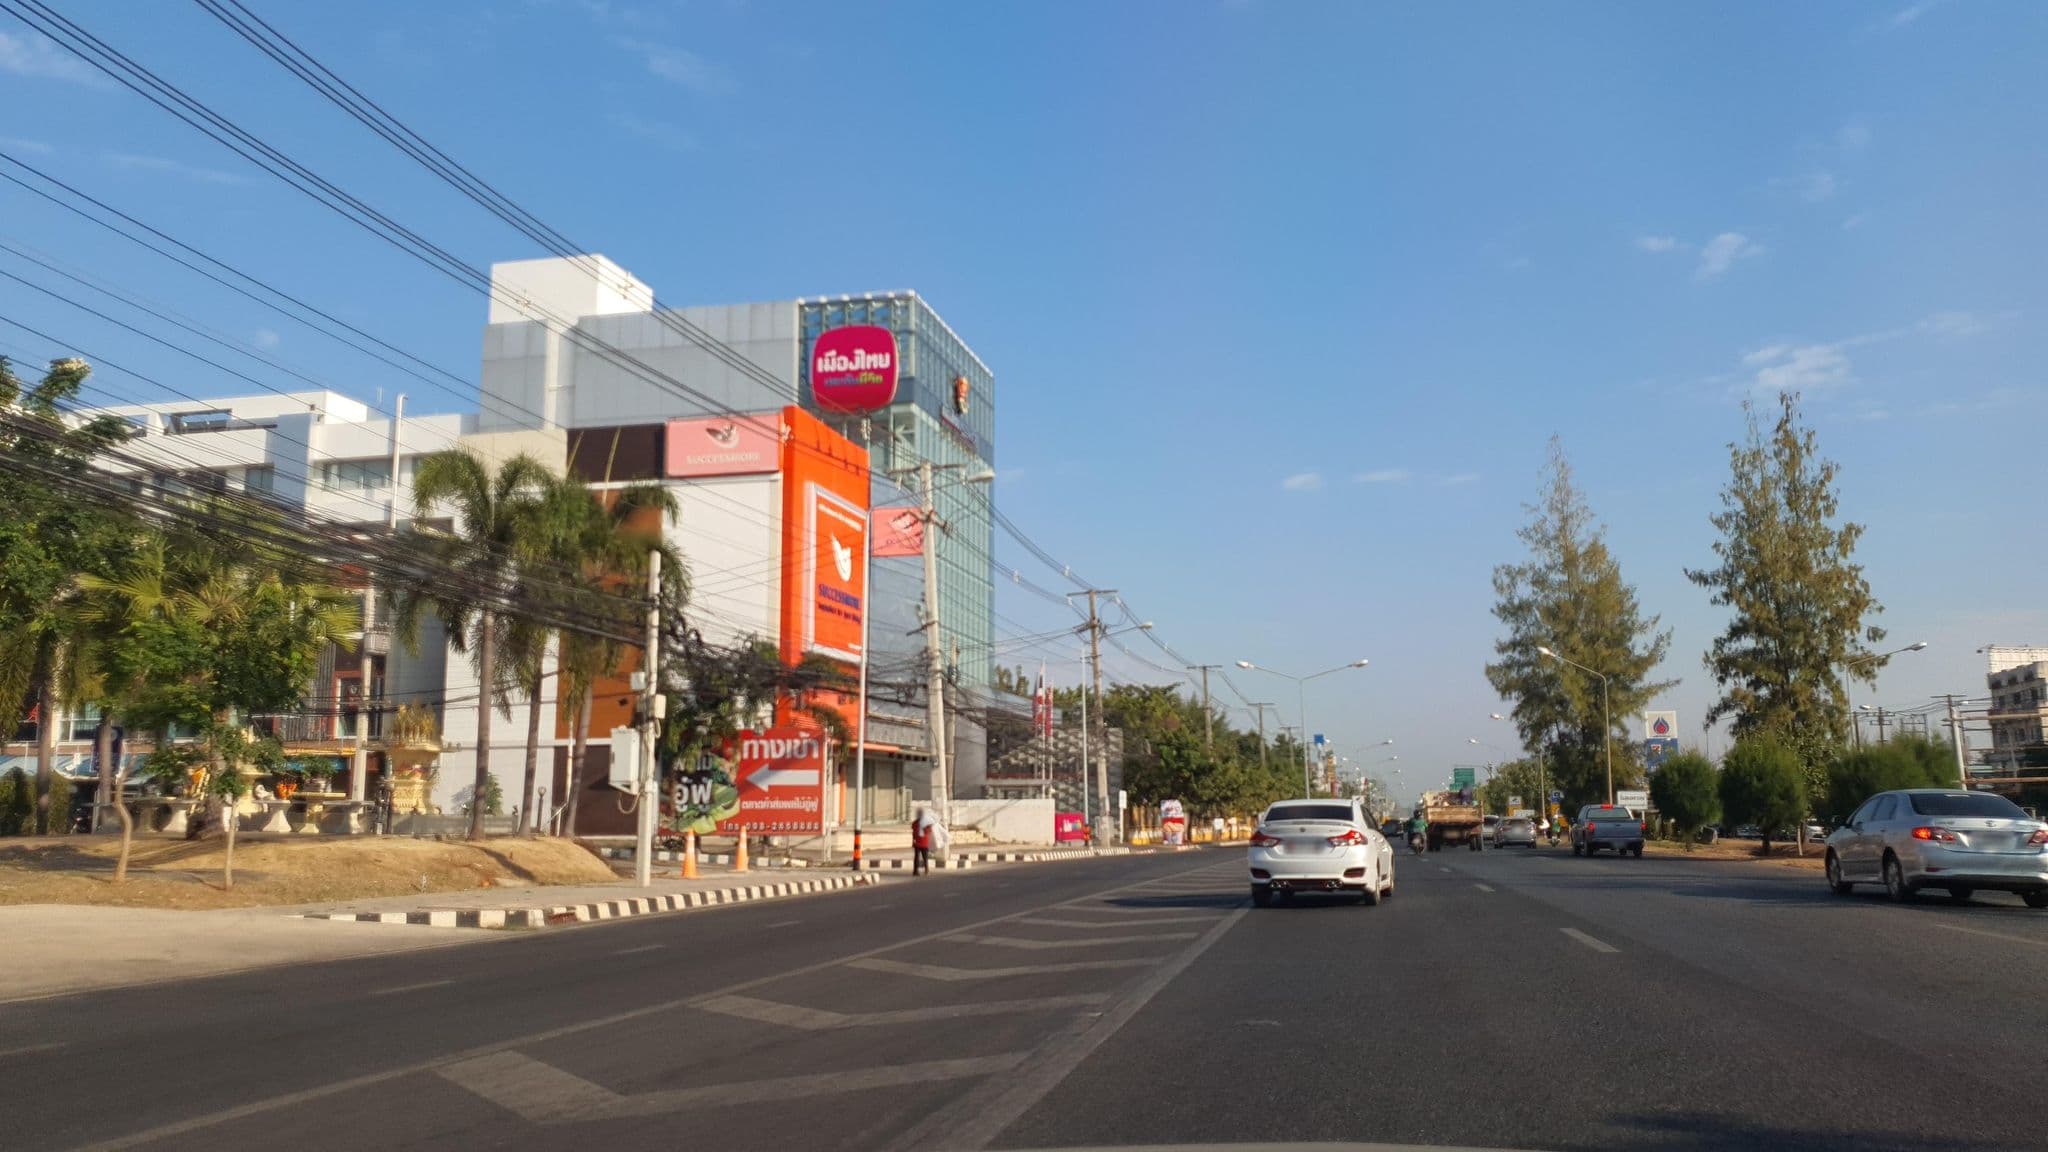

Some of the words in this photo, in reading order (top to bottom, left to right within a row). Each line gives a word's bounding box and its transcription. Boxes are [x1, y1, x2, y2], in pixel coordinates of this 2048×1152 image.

[817, 348, 890, 373] เมืองไทย
[742, 731, 819, 760] ทางเข้า
